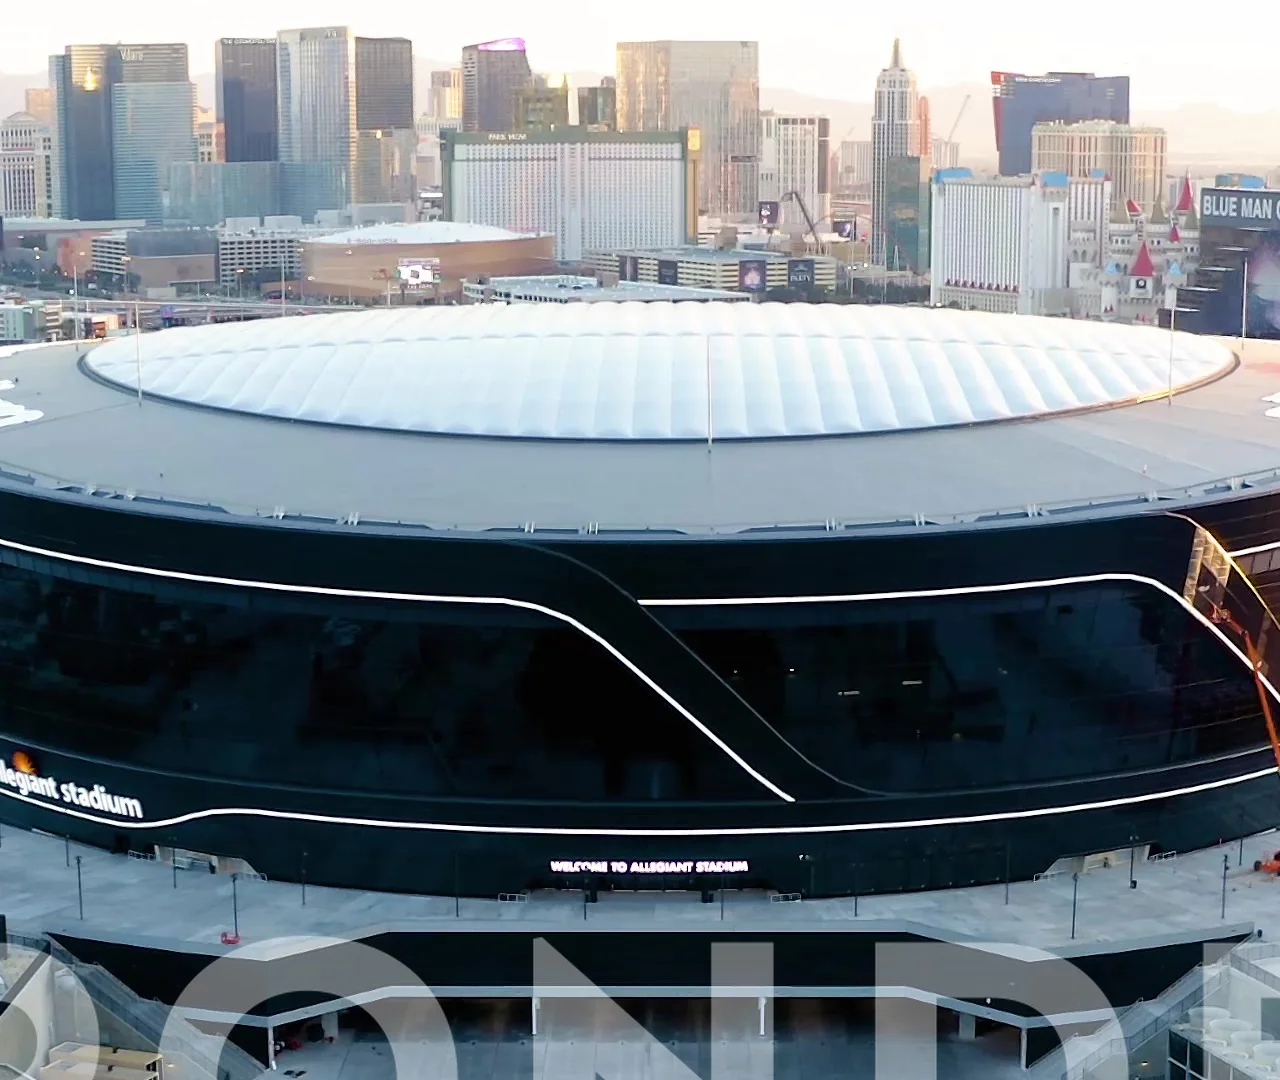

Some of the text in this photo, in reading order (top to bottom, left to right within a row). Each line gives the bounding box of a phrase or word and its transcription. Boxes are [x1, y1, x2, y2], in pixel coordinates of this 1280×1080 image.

[1203, 195, 1238, 217] BLUE
[1241, 197, 1273, 220] MAN
[60, 781, 144, 819] stadium
[550, 860, 749, 873] WELCOME TO ALLEGIANT STADIUM
